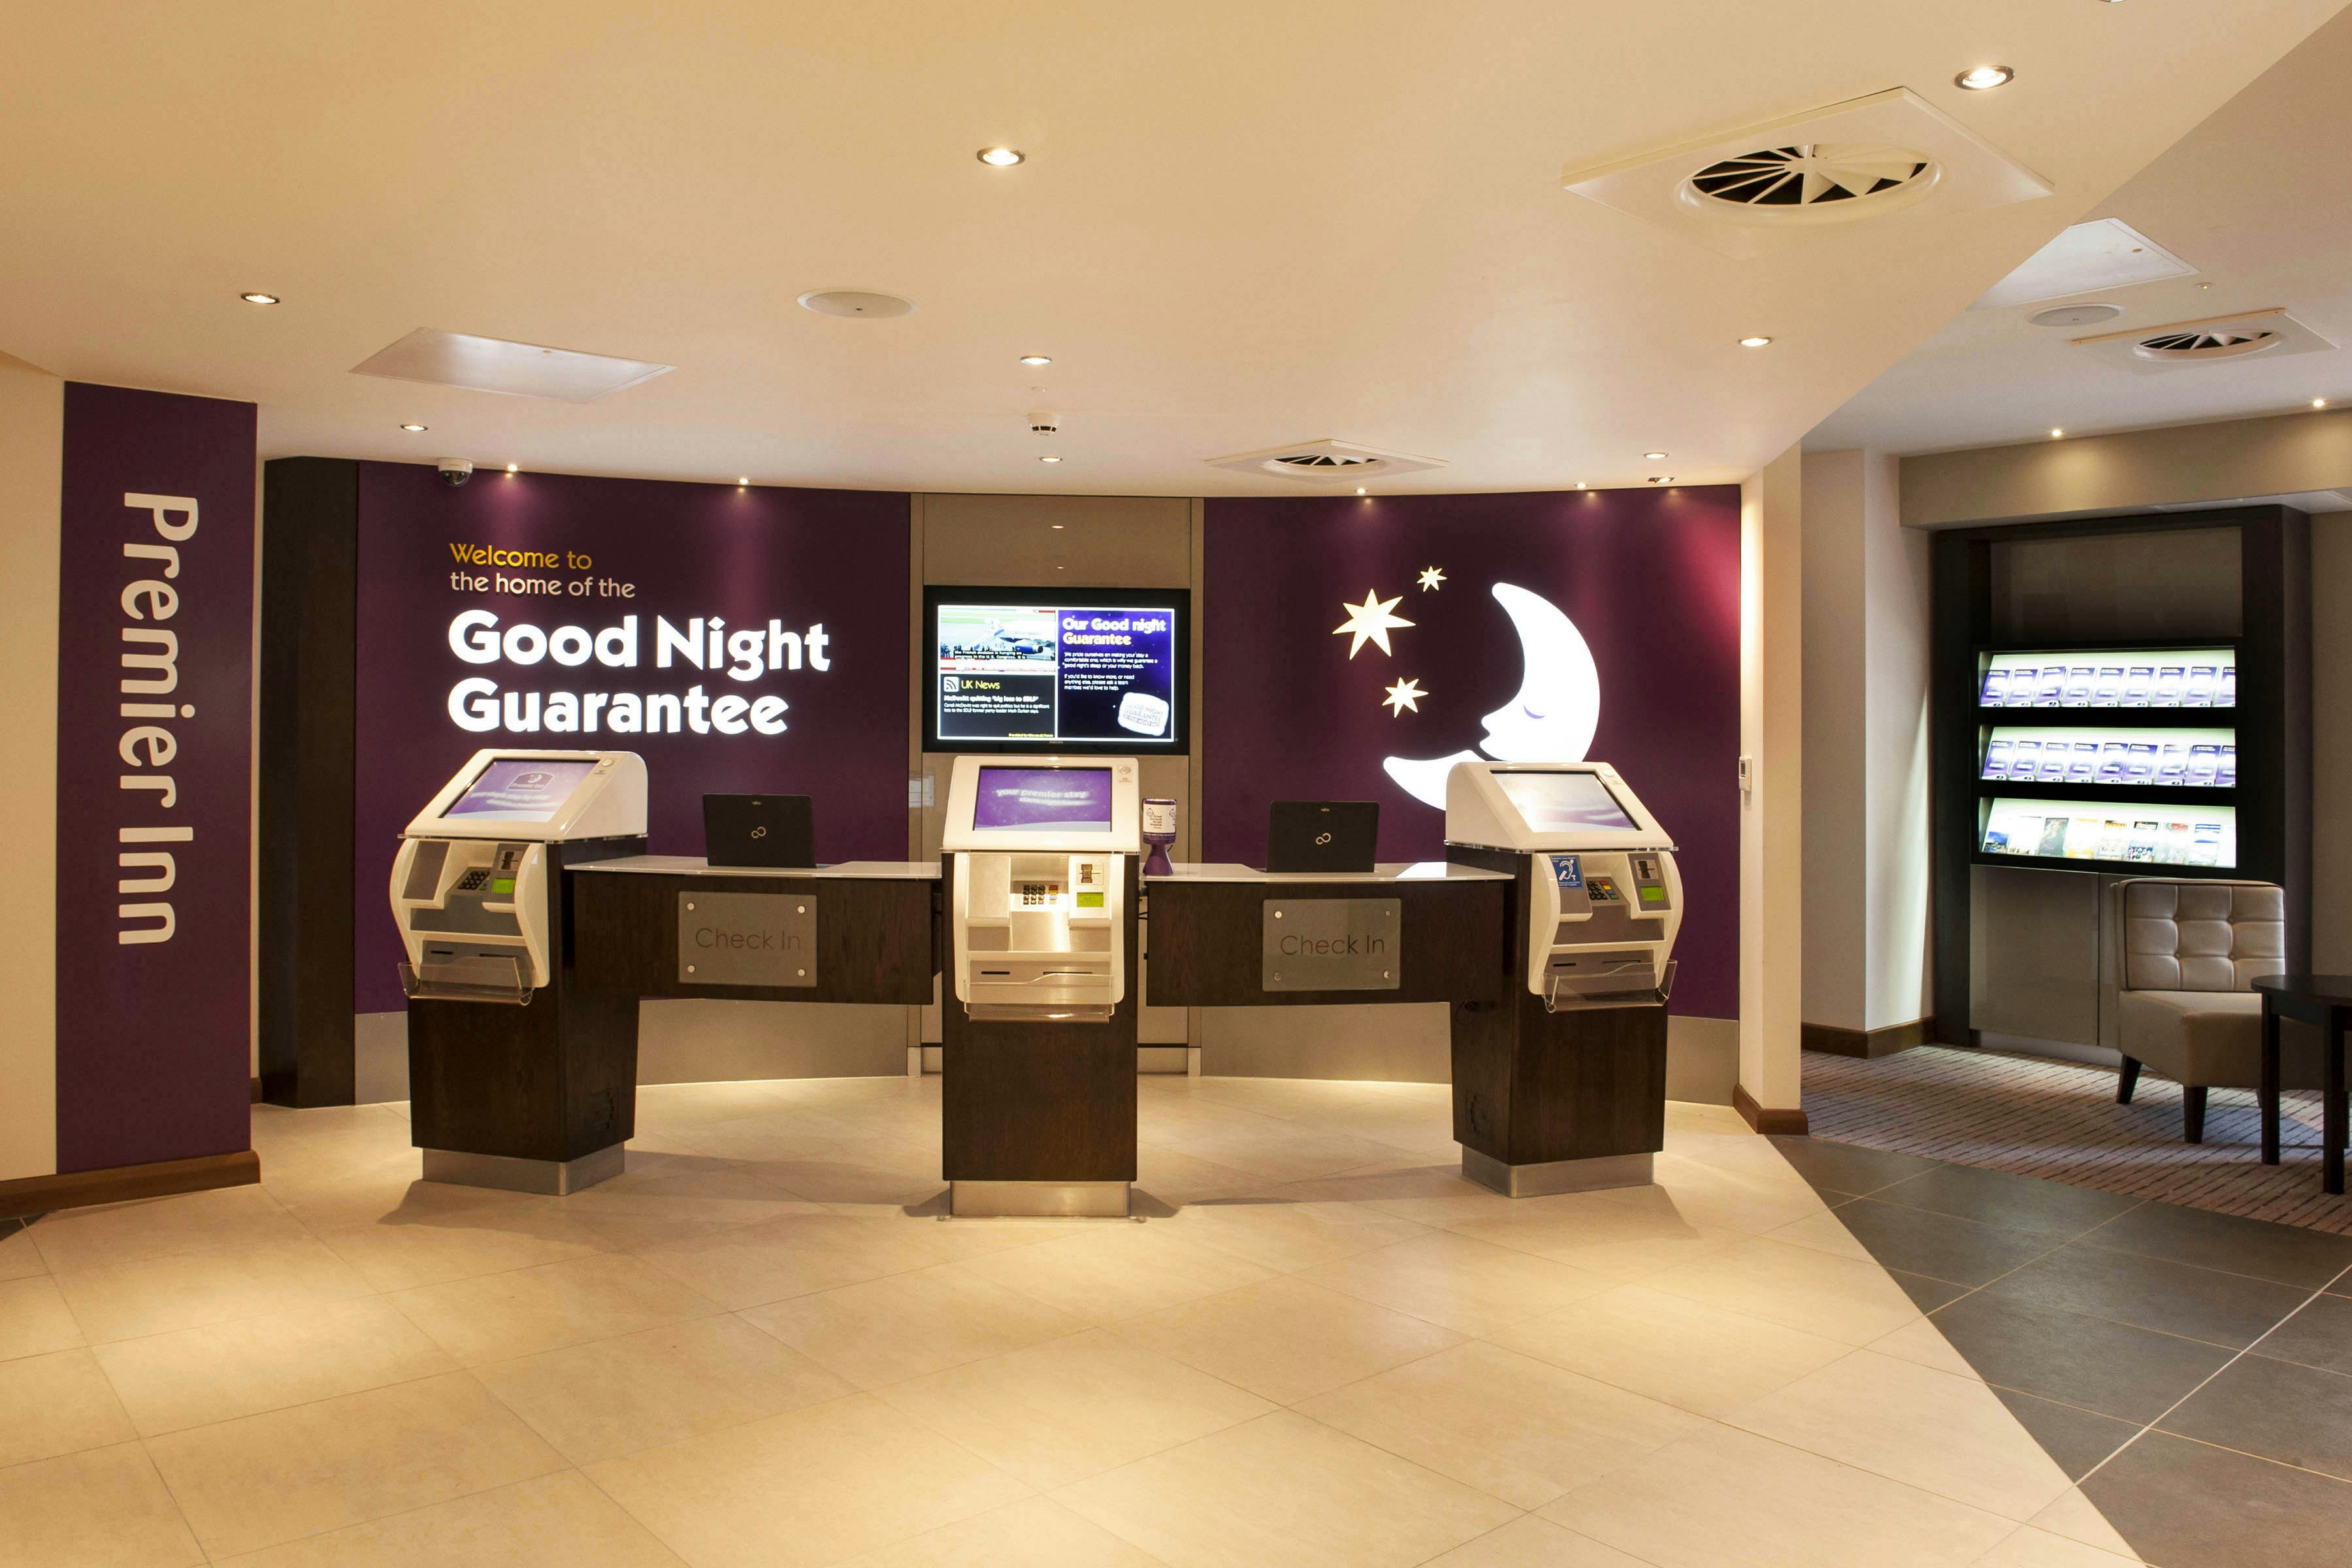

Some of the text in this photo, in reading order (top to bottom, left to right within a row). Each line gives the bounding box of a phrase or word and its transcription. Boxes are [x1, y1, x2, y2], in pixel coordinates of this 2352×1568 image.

[449, 543, 593, 570] Welcome to
[449, 572, 636, 598] the home of the
[1062, 617, 1166, 634] Our Good night
[448, 609, 831, 681] Good Night
[1062, 632, 1132, 645] Guarantee
[960, 680, 1000, 689] UK News
[447, 677, 790, 736] Guarantee
[118, 492, 199, 945] Premier Inn
[1021, 789, 1062, 798] premier
[1064, 791, 1089, 799] stay
[695, 928, 800, 951] Check In
[1280, 934, 1384, 956] Check In
